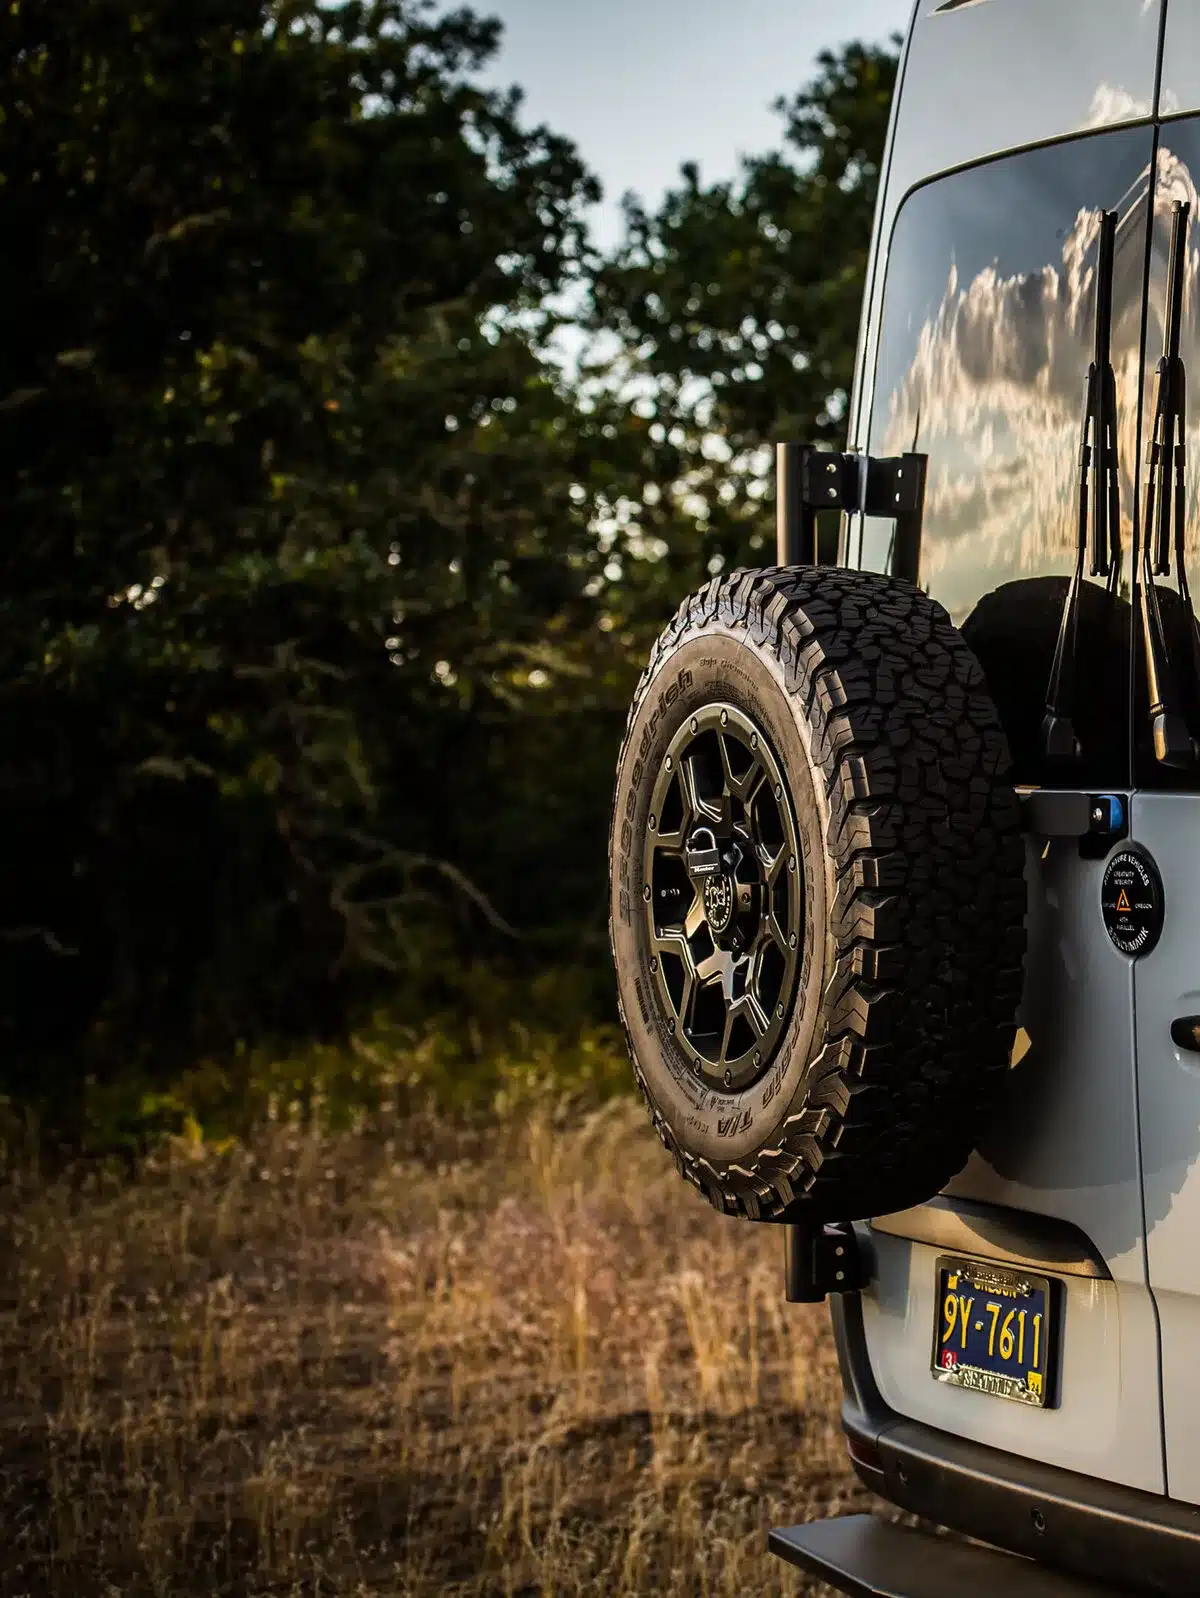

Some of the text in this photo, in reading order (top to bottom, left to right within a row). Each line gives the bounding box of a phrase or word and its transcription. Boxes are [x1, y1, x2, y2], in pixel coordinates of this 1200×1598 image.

[1128, 855, 1150, 887] VEHICLES
[1108, 926, 1149, 952] BENCHMARK
[945, 1352, 953, 1368] 3
[1031, 1383, 1039, 1392] 24
